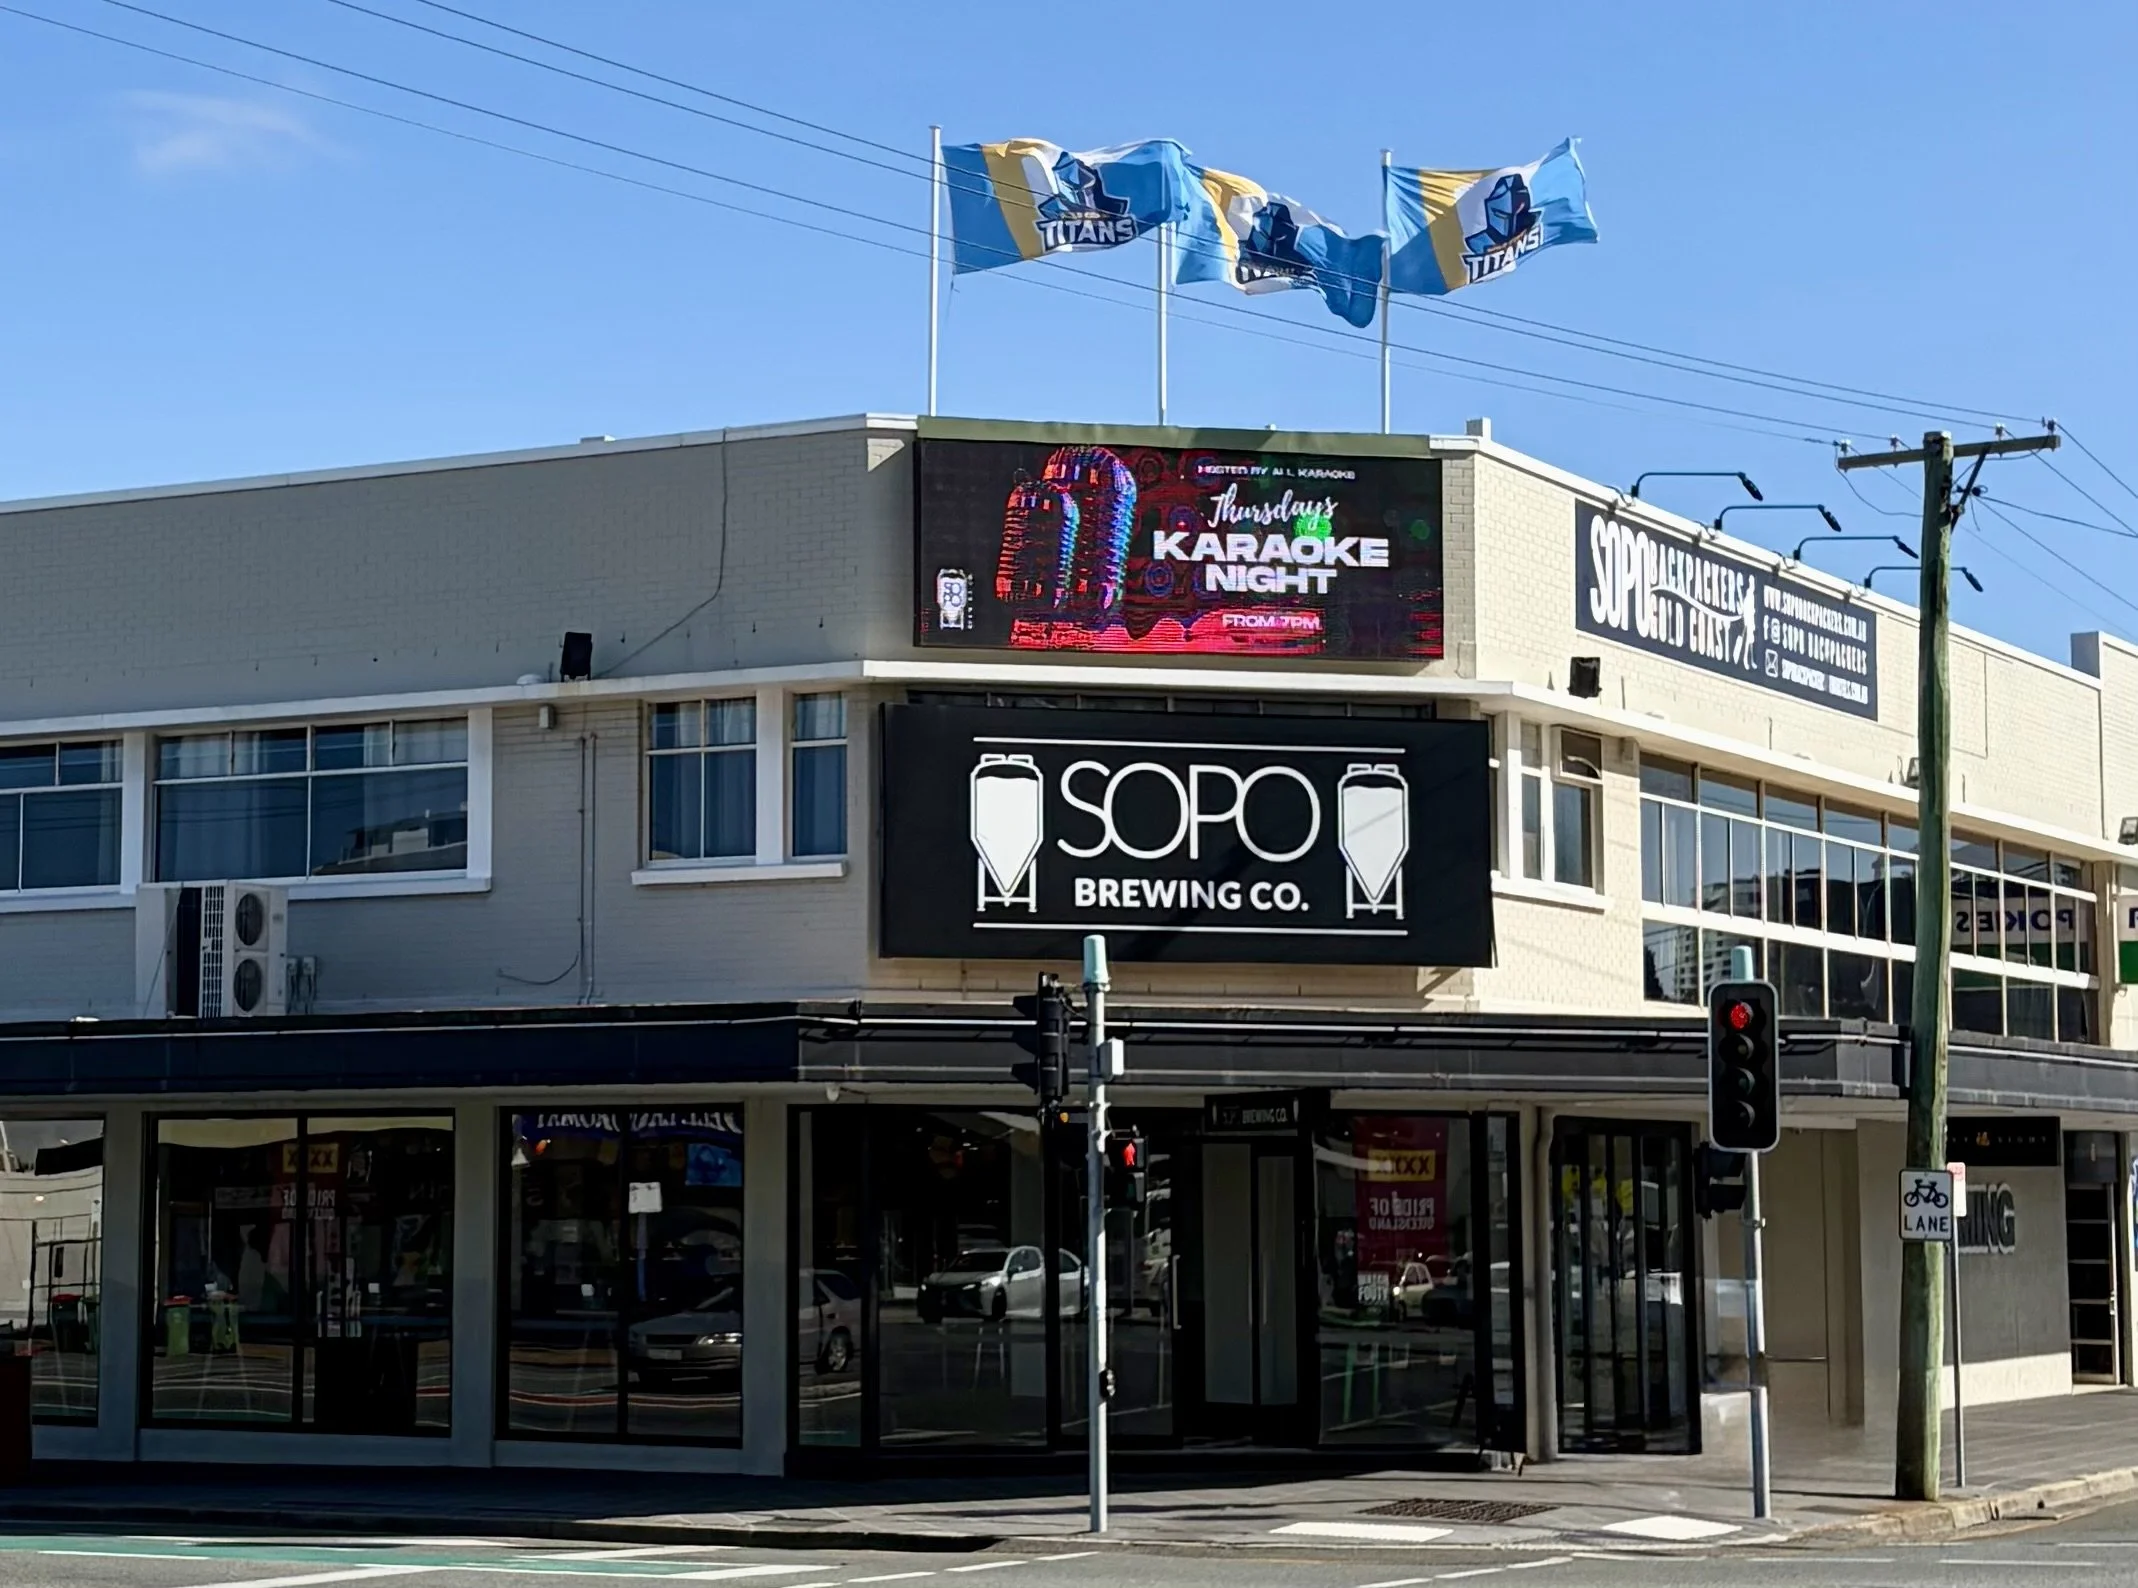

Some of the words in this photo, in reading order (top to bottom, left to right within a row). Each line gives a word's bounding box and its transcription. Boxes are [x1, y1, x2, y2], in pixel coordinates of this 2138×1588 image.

[1039, 218, 1134, 247] TITANS
[1465, 226, 1540, 280] TITANS
[1298, 468, 1356, 480] KARAOKE
[1207, 483, 1339, 533] Thursdays
[1153, 530, 1389, 568] KARAOKE
[1206, 564, 1338, 595] NIGHT
[1589, 514, 1652, 638] SOPO
[1649, 540, 1745, 616] BACKPACKERS
[1222, 613, 1276, 628] FROM
[1649, 592, 1685, 648] GOLD
[1689, 607, 1732, 664] COAST
[1057, 760, 1322, 863] SOPO
[1074, 877, 1242, 911] BREWING
[1249, 881, 1310, 912] CO.
[1904, 1215, 1949, 1233] LANE
[1955, 1183, 2016, 1255] MING
